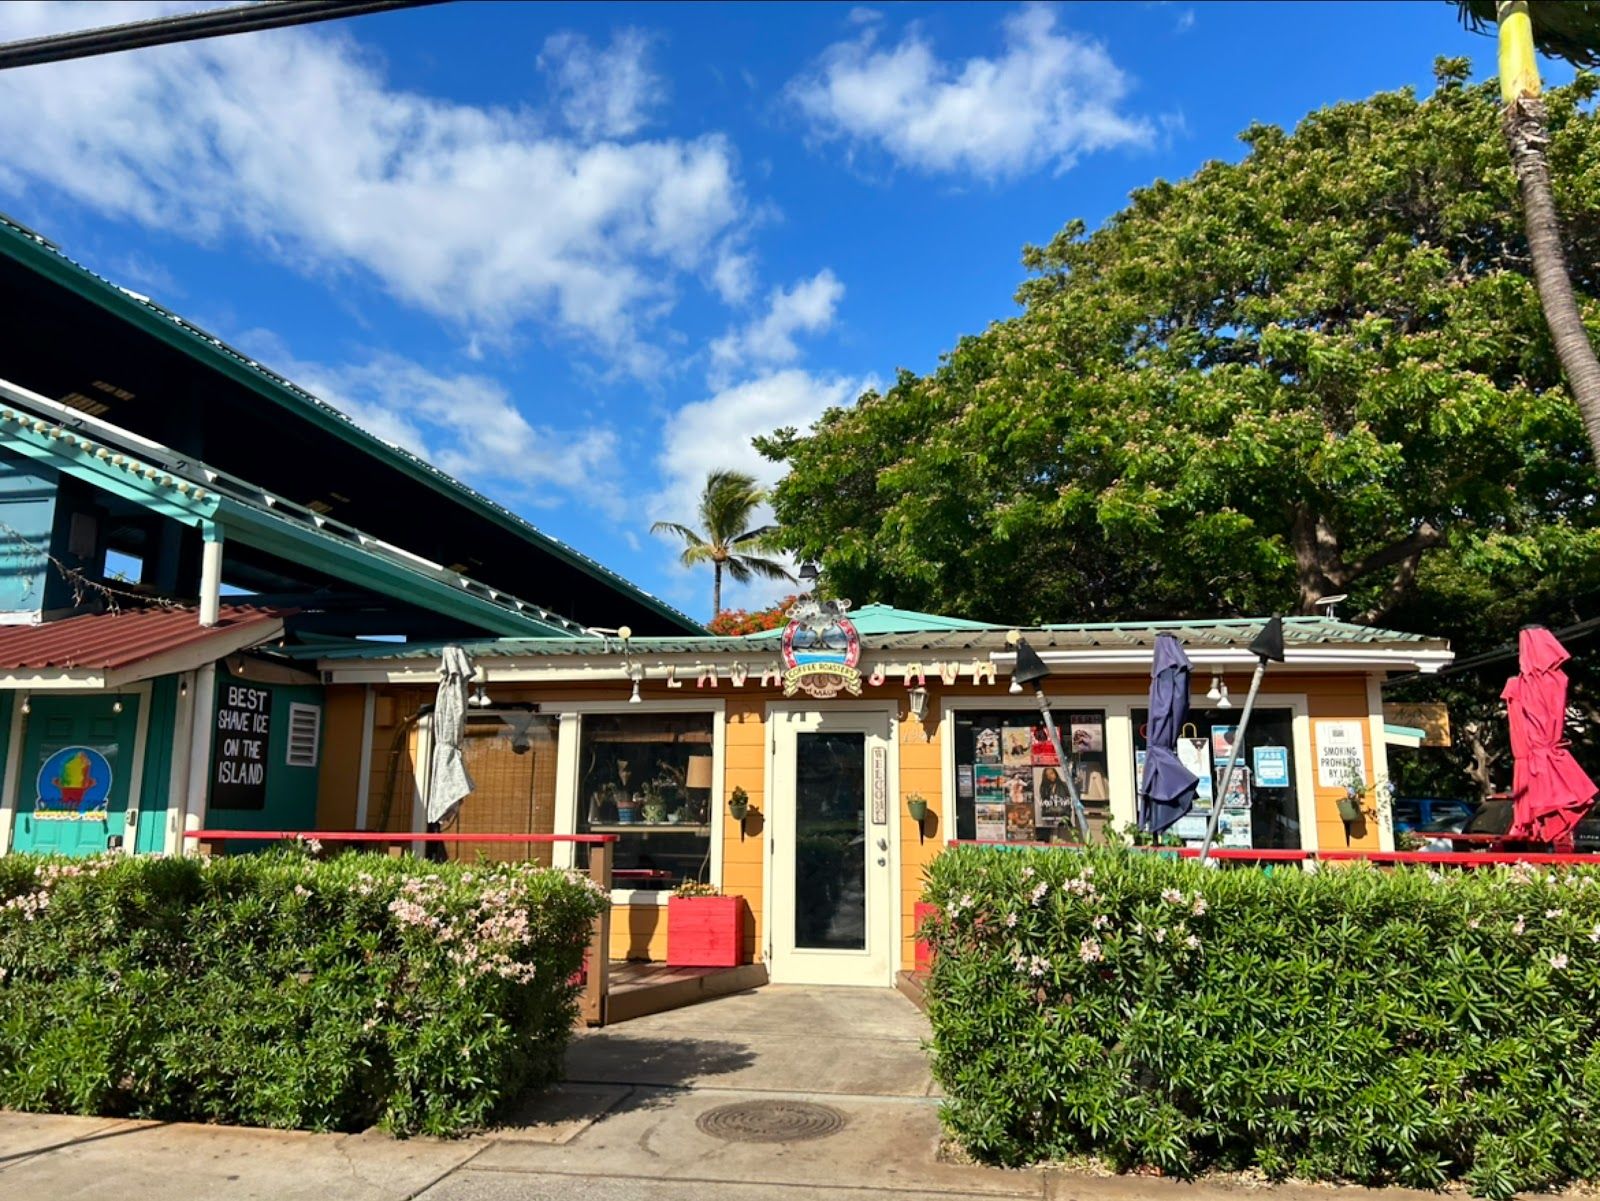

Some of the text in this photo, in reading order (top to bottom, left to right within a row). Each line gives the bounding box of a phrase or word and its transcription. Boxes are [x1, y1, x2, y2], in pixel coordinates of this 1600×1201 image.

[667, 661, 997, 688] LAVA JAVA
[788, 664, 854, 677] COFFEE ROASTERS
[228, 686, 267, 712] BEST
[218, 709, 269, 733] SHAVE ICE
[223, 739, 261, 759] ON THE
[1323, 746, 1357, 756] SMOKING
[218, 761, 263, 784] ISLAND
[1329, 769, 1337, 778] BY
[874, 748, 884, 822] WELCOME
